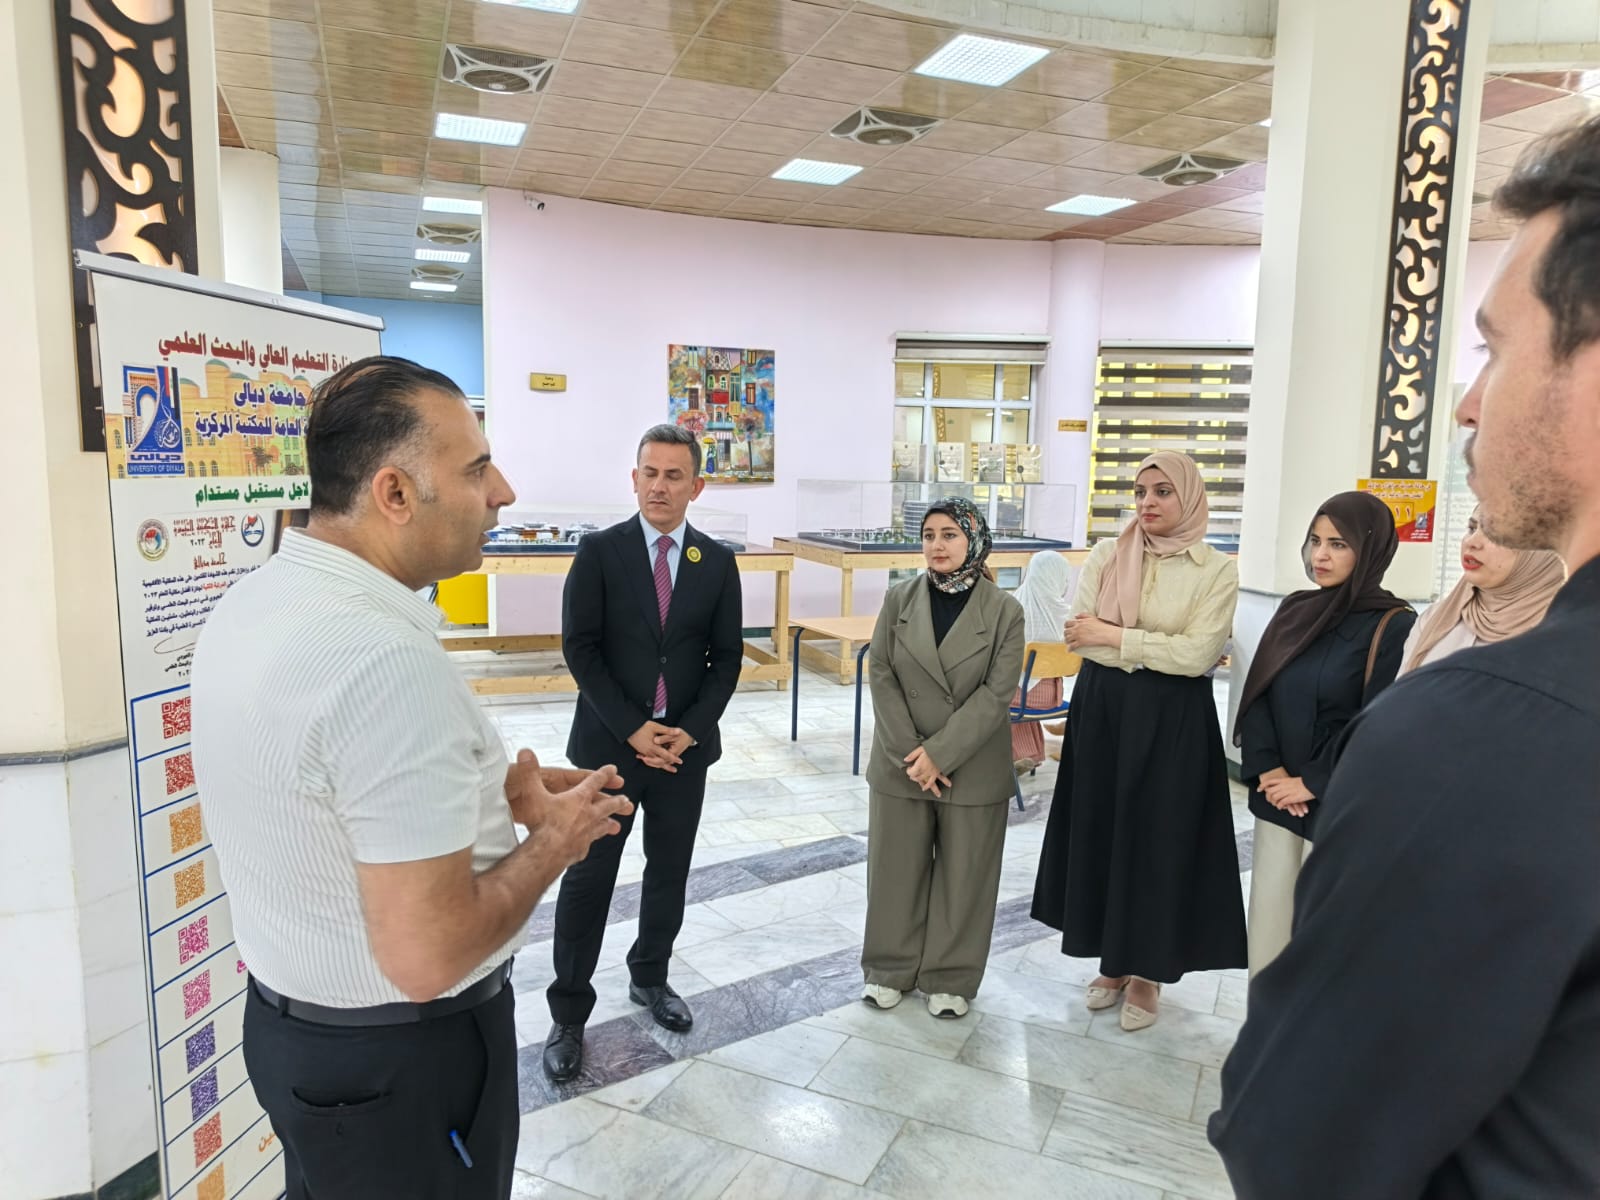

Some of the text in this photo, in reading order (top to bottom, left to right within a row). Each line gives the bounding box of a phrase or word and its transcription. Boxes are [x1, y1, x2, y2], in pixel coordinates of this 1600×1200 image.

[158, 330, 206, 361] العلمي
[210, 337, 256, 367] والبحث
[259, 344, 288, 373] العالي
[292, 350, 329, 375] التعليم
[268, 383, 306, 411] جامعة
[194, 411, 233, 439] المركزية
[235, 415, 273, 439] للمكتبة
[274, 415, 301, 438] العامة
[127, 463, 185, 473] UNIVERSITY OF DIYALA
[194, 484, 240, 508] مستدام
[243, 482, 285, 504] مستقبل
